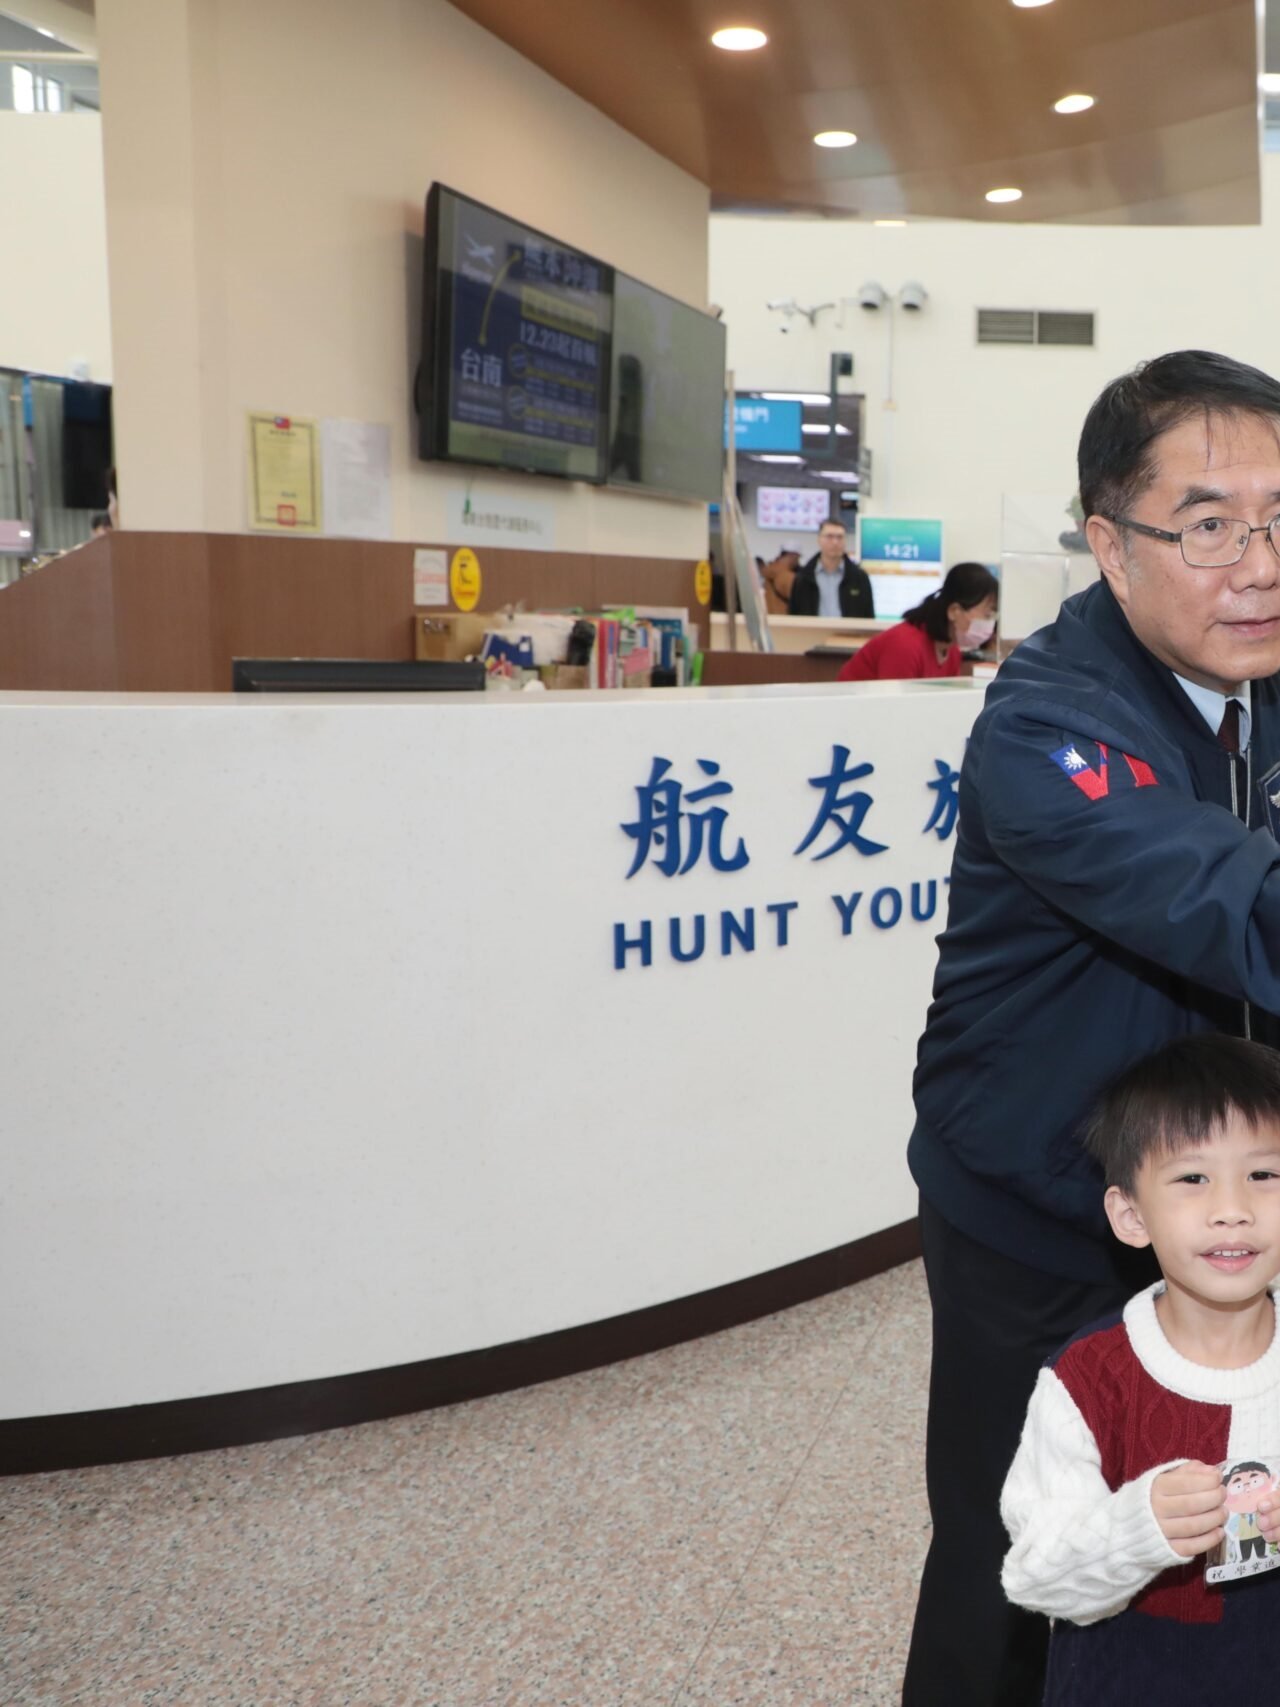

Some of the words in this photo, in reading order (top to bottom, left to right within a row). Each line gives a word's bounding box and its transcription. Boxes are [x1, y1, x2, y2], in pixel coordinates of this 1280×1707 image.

[461, 348, 502, 386] 台南
[884, 543, 919, 559] 14:21
[613, 901, 799, 970] HUNT
[831, 876, 952, 936] YOU
